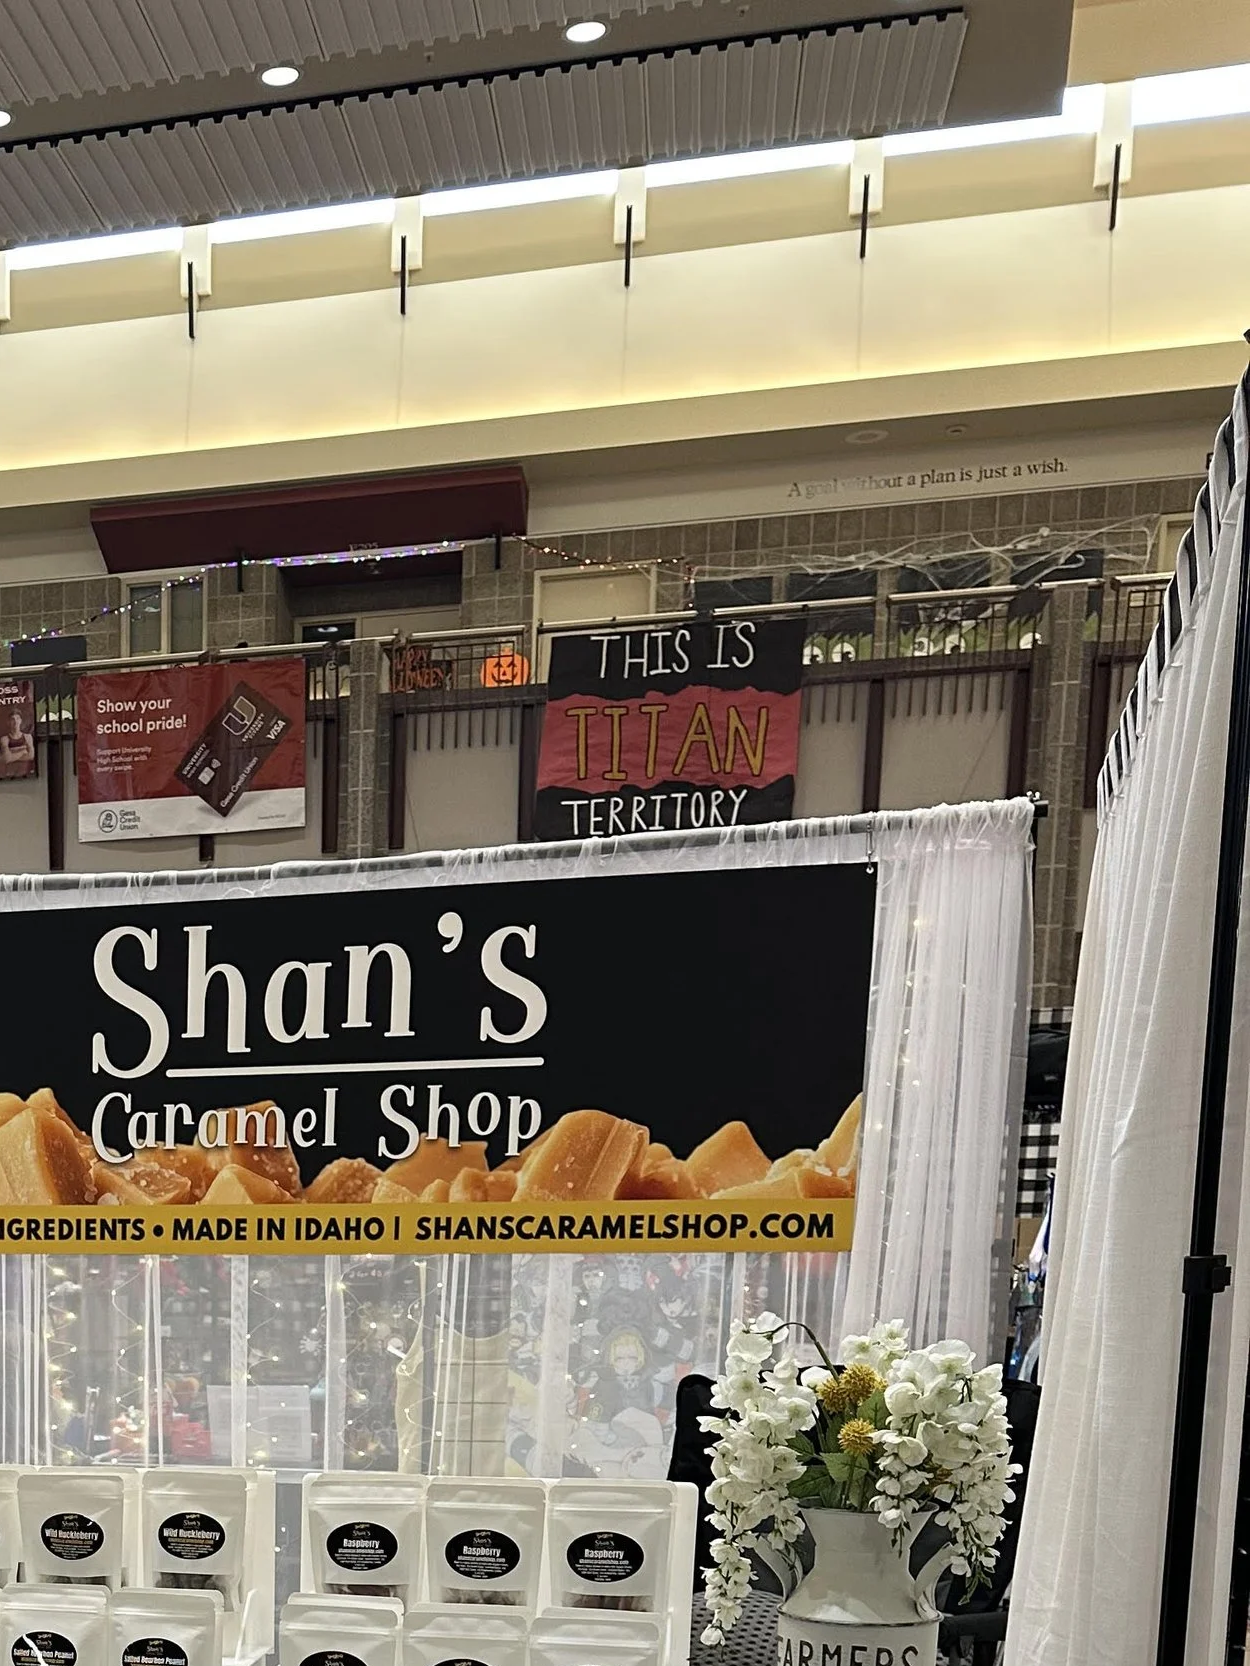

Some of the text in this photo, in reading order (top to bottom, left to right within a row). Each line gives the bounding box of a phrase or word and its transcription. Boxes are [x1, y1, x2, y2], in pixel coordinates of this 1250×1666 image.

[788, 483, 802, 497] A
[805, 479, 838, 499] goal
[907, 475, 916, 486] a
[920, 469, 955, 488] plan
[959, 467, 972, 482] is
[976, 464, 1007, 482] just
[1013, 466, 1022, 476] a
[1027, 458, 1068, 475] wish.
[590, 622, 757, 679] THIS IS
[97, 698, 173, 714] Show your
[97, 714, 188, 735] school pride!
[266, 719, 287, 741] VISA
[565, 703, 770, 781] TITAN
[561, 790, 748, 836] TERRITORY
[91, 912, 548, 1079] Shan's
[92, 1084, 542, 1164] Caramel Shop
[171, 1217, 248, 1241] MADE
[256, 1217, 287, 1241] IN
[294, 1216, 385, 1242] IDAHO
[415, 1213, 835, 1241] SHANSCARAMELSHOP.COM
[343, 1538, 380, 1549] Raspberry
[463, 1545, 501, 1558] Raspberry
[584, 1549, 625, 1561] Raspberry
